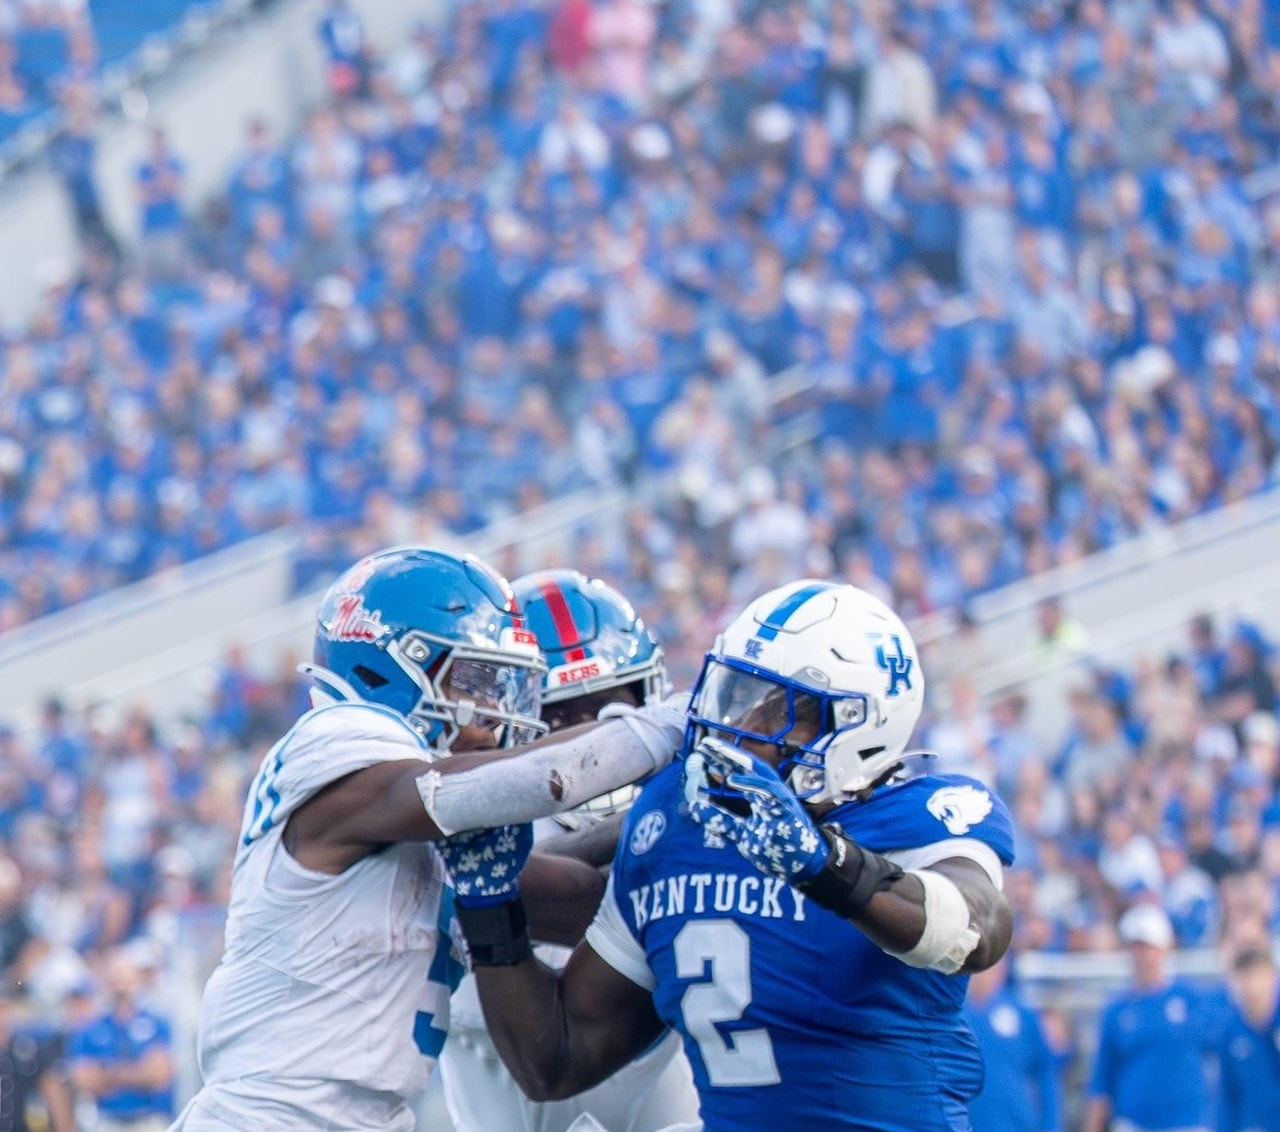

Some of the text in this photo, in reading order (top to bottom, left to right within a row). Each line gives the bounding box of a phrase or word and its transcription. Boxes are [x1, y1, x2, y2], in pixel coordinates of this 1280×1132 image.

[558, 663, 600, 684] REBS
[867, 632, 913, 697] UK
[628, 872, 806, 932] KENTUCKY
[673, 918, 782, 1087] 2
